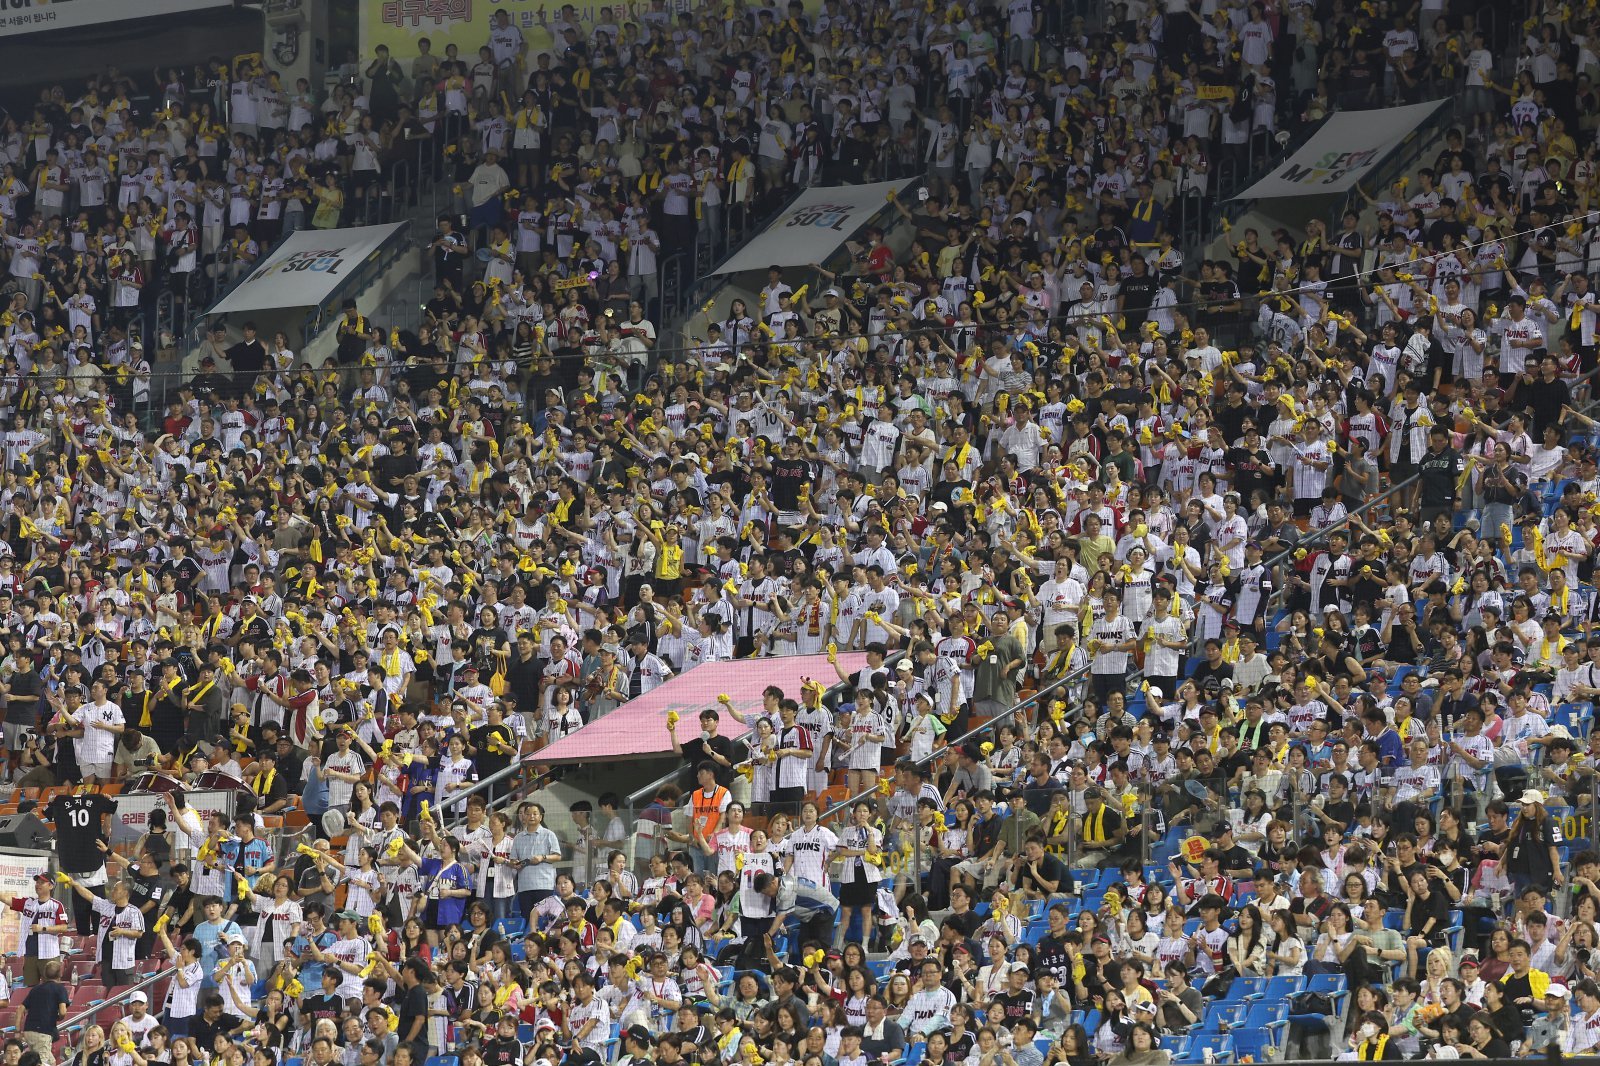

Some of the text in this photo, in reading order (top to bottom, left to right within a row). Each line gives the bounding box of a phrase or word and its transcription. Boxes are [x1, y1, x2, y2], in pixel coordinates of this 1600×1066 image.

[383, 0, 472, 27] 타구주의
[9, 16, 32, 26] 서울이
[786, 213, 850, 231] SOUL
[282, 258, 344, 275] SOUL
[576, 276, 586, 284] LG
[762, 411, 777, 426] 10
[1199, 456, 1225, 467] SEOUL
[518, 532, 540, 540] TWINS
[1096, 631, 1123, 640] TWINS
[65, 800, 93, 811] 오지환
[694, 806, 719, 814] TWINS
[68, 810, 89, 828] 10
[122, 813, 145, 825] 승리를
[719, 843, 747, 853] TWINS
[1042, 954, 1065, 965] 나균안
[914, 1010, 935, 1019] TWIN
